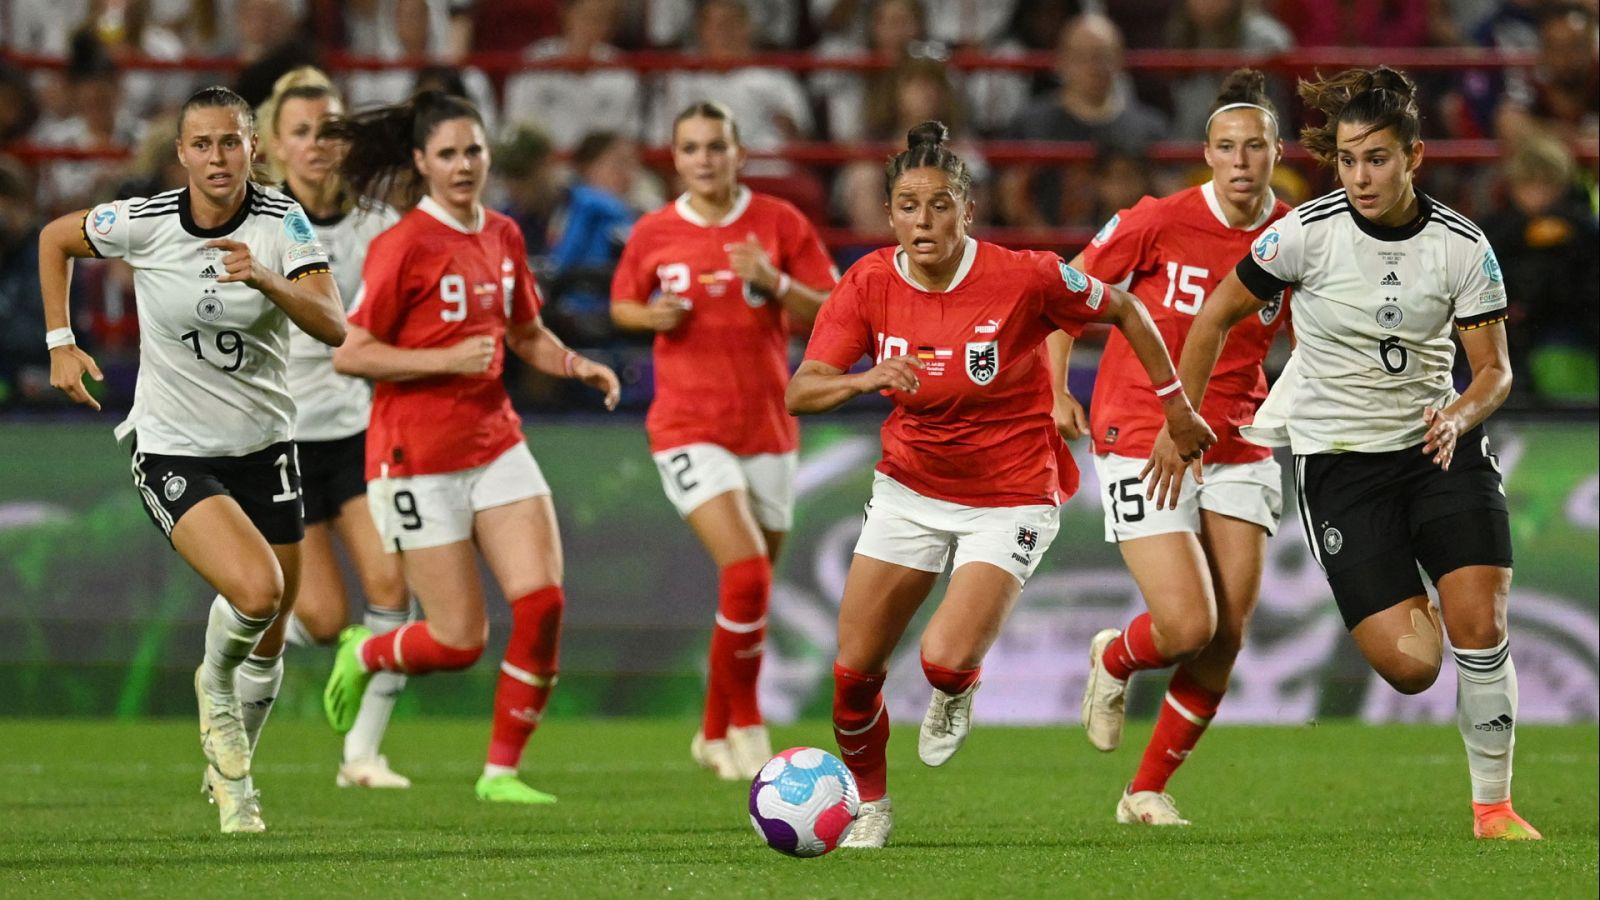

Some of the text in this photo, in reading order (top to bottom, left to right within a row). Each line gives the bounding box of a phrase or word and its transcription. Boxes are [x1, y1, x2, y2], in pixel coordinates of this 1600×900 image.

[440, 274, 468, 323] 9
[1162, 261, 1209, 316] 15
[181, 329, 244, 373] 19
[1379, 335, 1408, 374] 6
[272, 444, 303, 503] 1
[670, 452, 699, 492] 2
[393, 490, 423, 530] 9
[1108, 477, 1145, 524] 15
